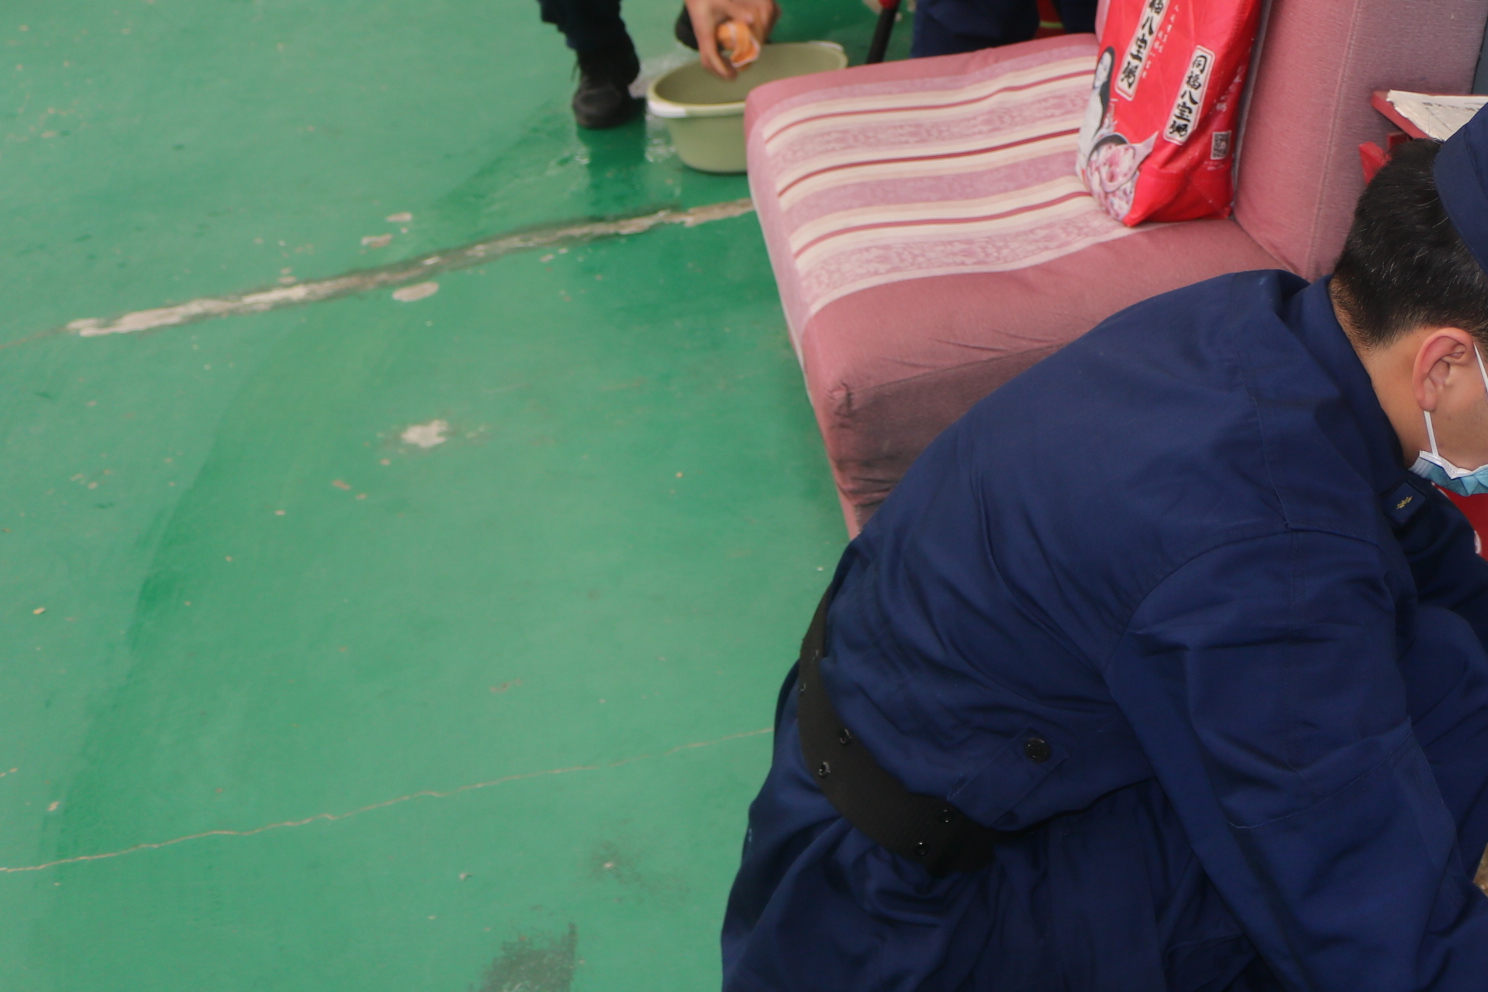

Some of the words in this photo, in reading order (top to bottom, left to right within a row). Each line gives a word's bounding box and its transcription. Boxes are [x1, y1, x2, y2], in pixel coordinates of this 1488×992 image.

[1169, 55, 1207, 137] 同福八宝粥
